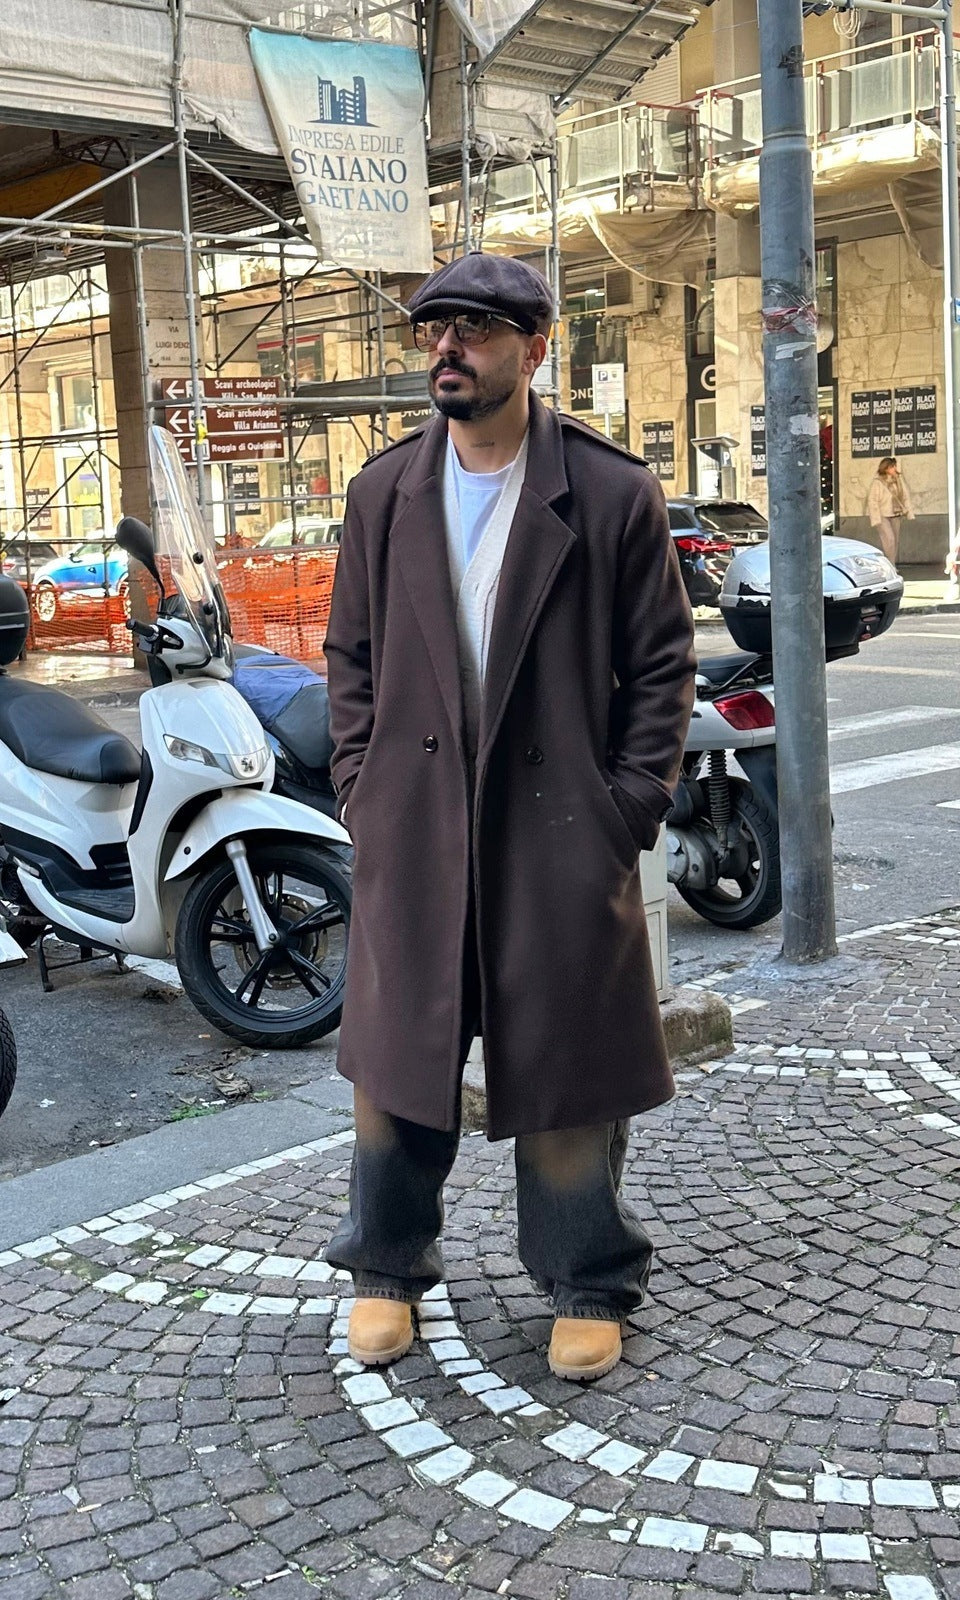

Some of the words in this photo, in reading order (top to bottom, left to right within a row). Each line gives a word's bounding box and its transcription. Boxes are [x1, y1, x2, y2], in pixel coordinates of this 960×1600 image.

[361, 134, 405, 154] EDILE
[290, 148, 407, 184] STAIANO
[296, 181, 409, 213] GAETANO
[214, 380, 233, 389] Scavi
[236, 379, 276, 390] archeologici
[873, 400, 891, 408] BLACK
[894, 397, 913, 406] BLACK
[917, 395, 935, 404] BLACK
[852, 402, 870, 410] BLACK
[894, 405, 913, 413] FRIDAY
[917, 402, 935, 410] FRIDAY
[217, 410, 234, 418] Scavi
[238, 408, 277, 418] archeologici
[852, 409, 870, 417] FRIDAY
[234, 421, 250, 430] Villa
[253, 421, 277, 429] Arianna
[874, 435, 892, 444] BLACK
[894, 433, 913, 441] BLACK
[917, 431, 936, 440] BLACK
[852, 437, 870, 445] BLACK
[894, 440, 913, 448] FRIDAY
[917, 438, 936, 447] FRIDAY
[212, 444, 236, 453] Reggia
[239, 442, 246, 450] di
[248, 442, 282, 450] Quisisana
[852, 444, 870, 452] FRIDAY
[874, 442, 891, 450] FRIDAY
